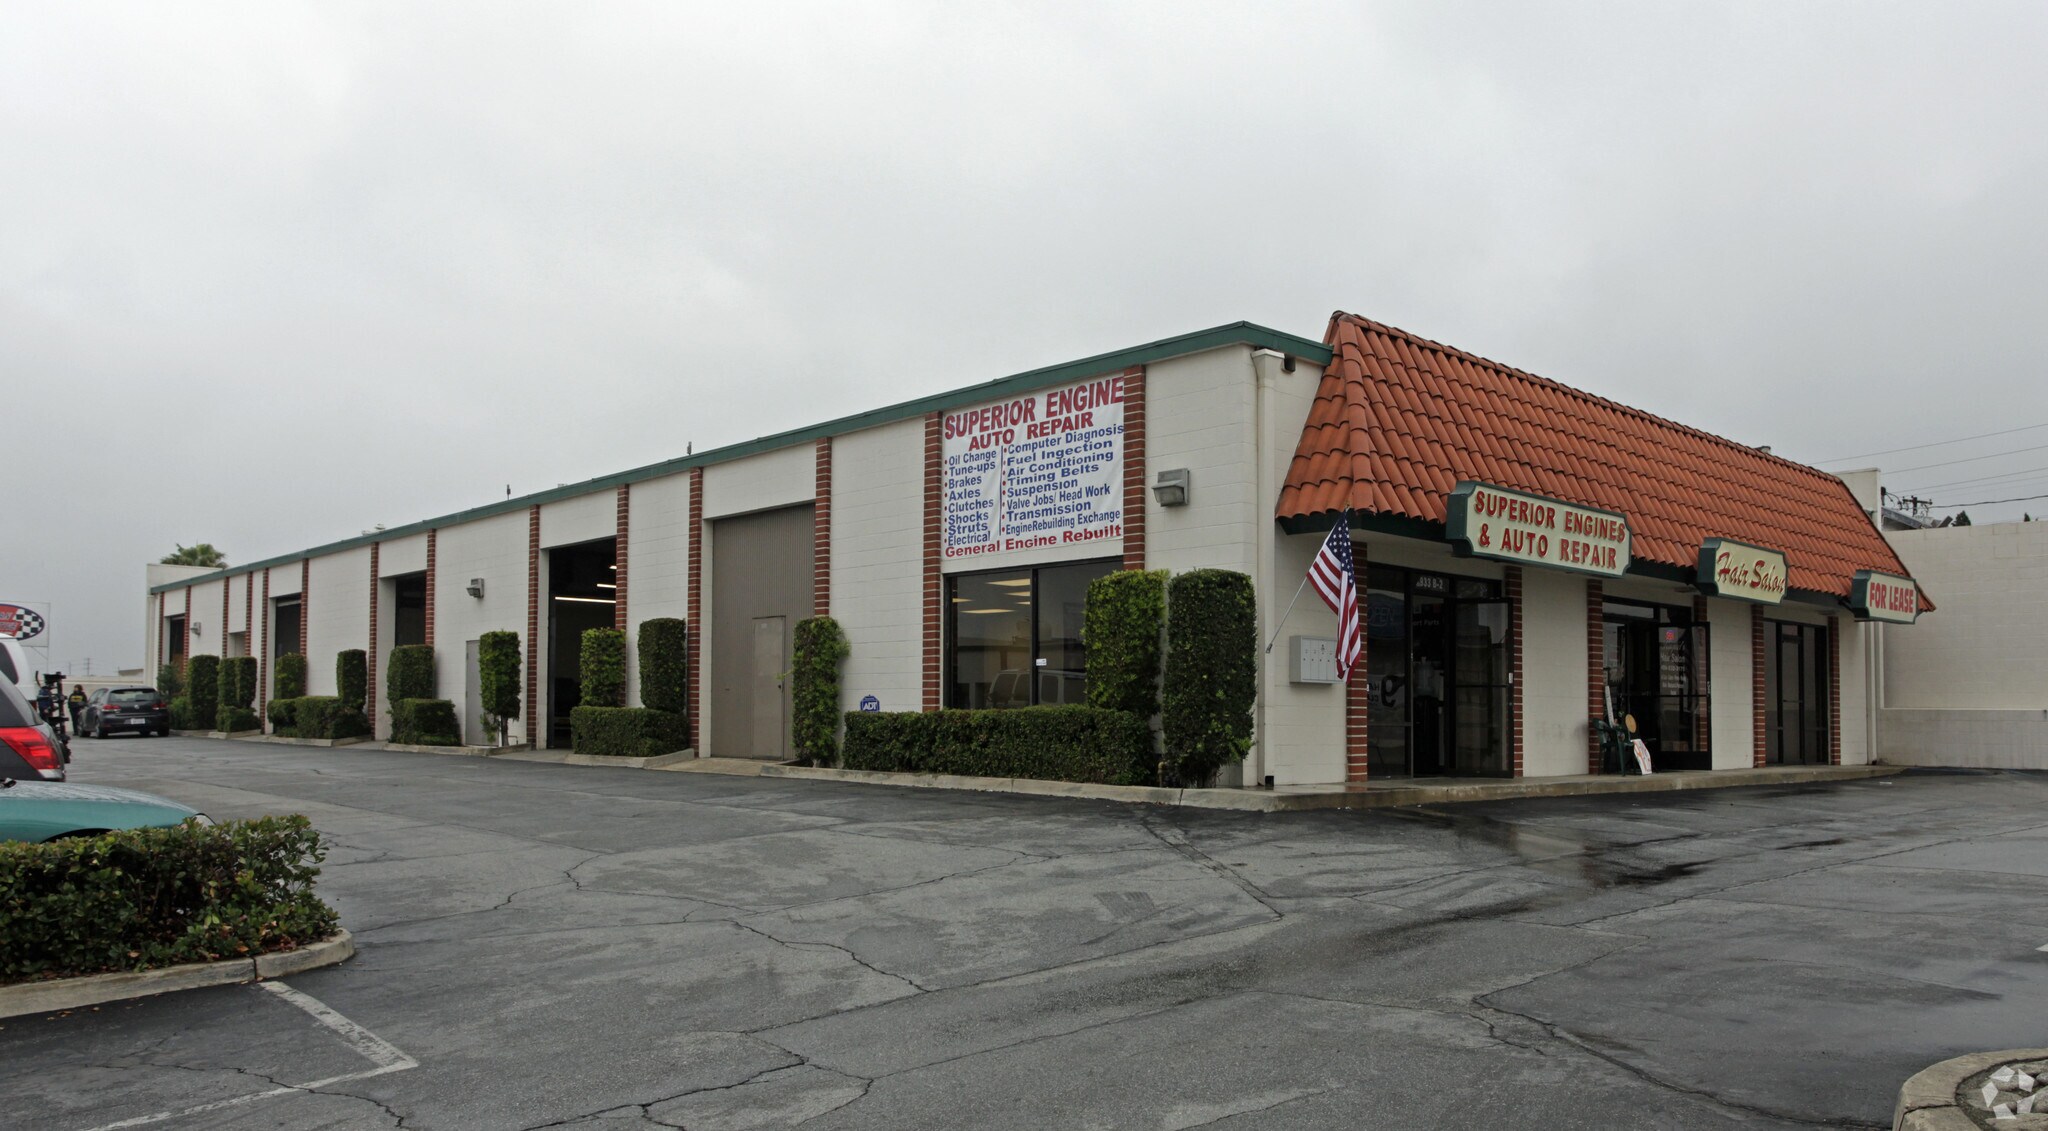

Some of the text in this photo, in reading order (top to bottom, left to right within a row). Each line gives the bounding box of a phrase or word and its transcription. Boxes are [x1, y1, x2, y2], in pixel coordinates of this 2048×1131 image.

[945, 377, 1124, 440] SUPERIOR ENGINE
[969, 412, 1093, 451] AUTO REPAIR
[1008, 424, 1124, 456] Computer Diagnosis
[949, 450, 997, 466] Oil Change
[1007, 453, 1036, 466] Fuel
[1008, 451, 1114, 477] Air Conditioning
[949, 461, 995, 478] Tune-ups
[1008, 463, 1099, 487] Timing Belts
[949, 475, 982, 489] Brakes
[1008, 479, 1078, 498] Suspension
[949, 488, 981, 501] Axles
[1007, 497, 1030, 511] Valve
[1060, 487, 1082, 502] Head
[1085, 484, 1110, 497] Work
[949, 498, 994, 513] Clutches
[1007, 501, 1091, 522] Transmission
[948, 511, 989, 525] Shocks
[1078, 509, 1120, 526] Exchange
[1474, 491, 1625, 543] SUPERIOR ENGINES
[948, 521, 988, 536] Struts
[946, 524, 1121, 557] General Engine Rebuilt
[948, 531, 990, 547] Electrical
[1480, 523, 1616, 569] & AUTO REPAIR
[1717, 551, 1785, 593] Hair Salon
[1869, 583, 1914, 613] FOR LEASE
[863, 702, 877, 710] ADT
